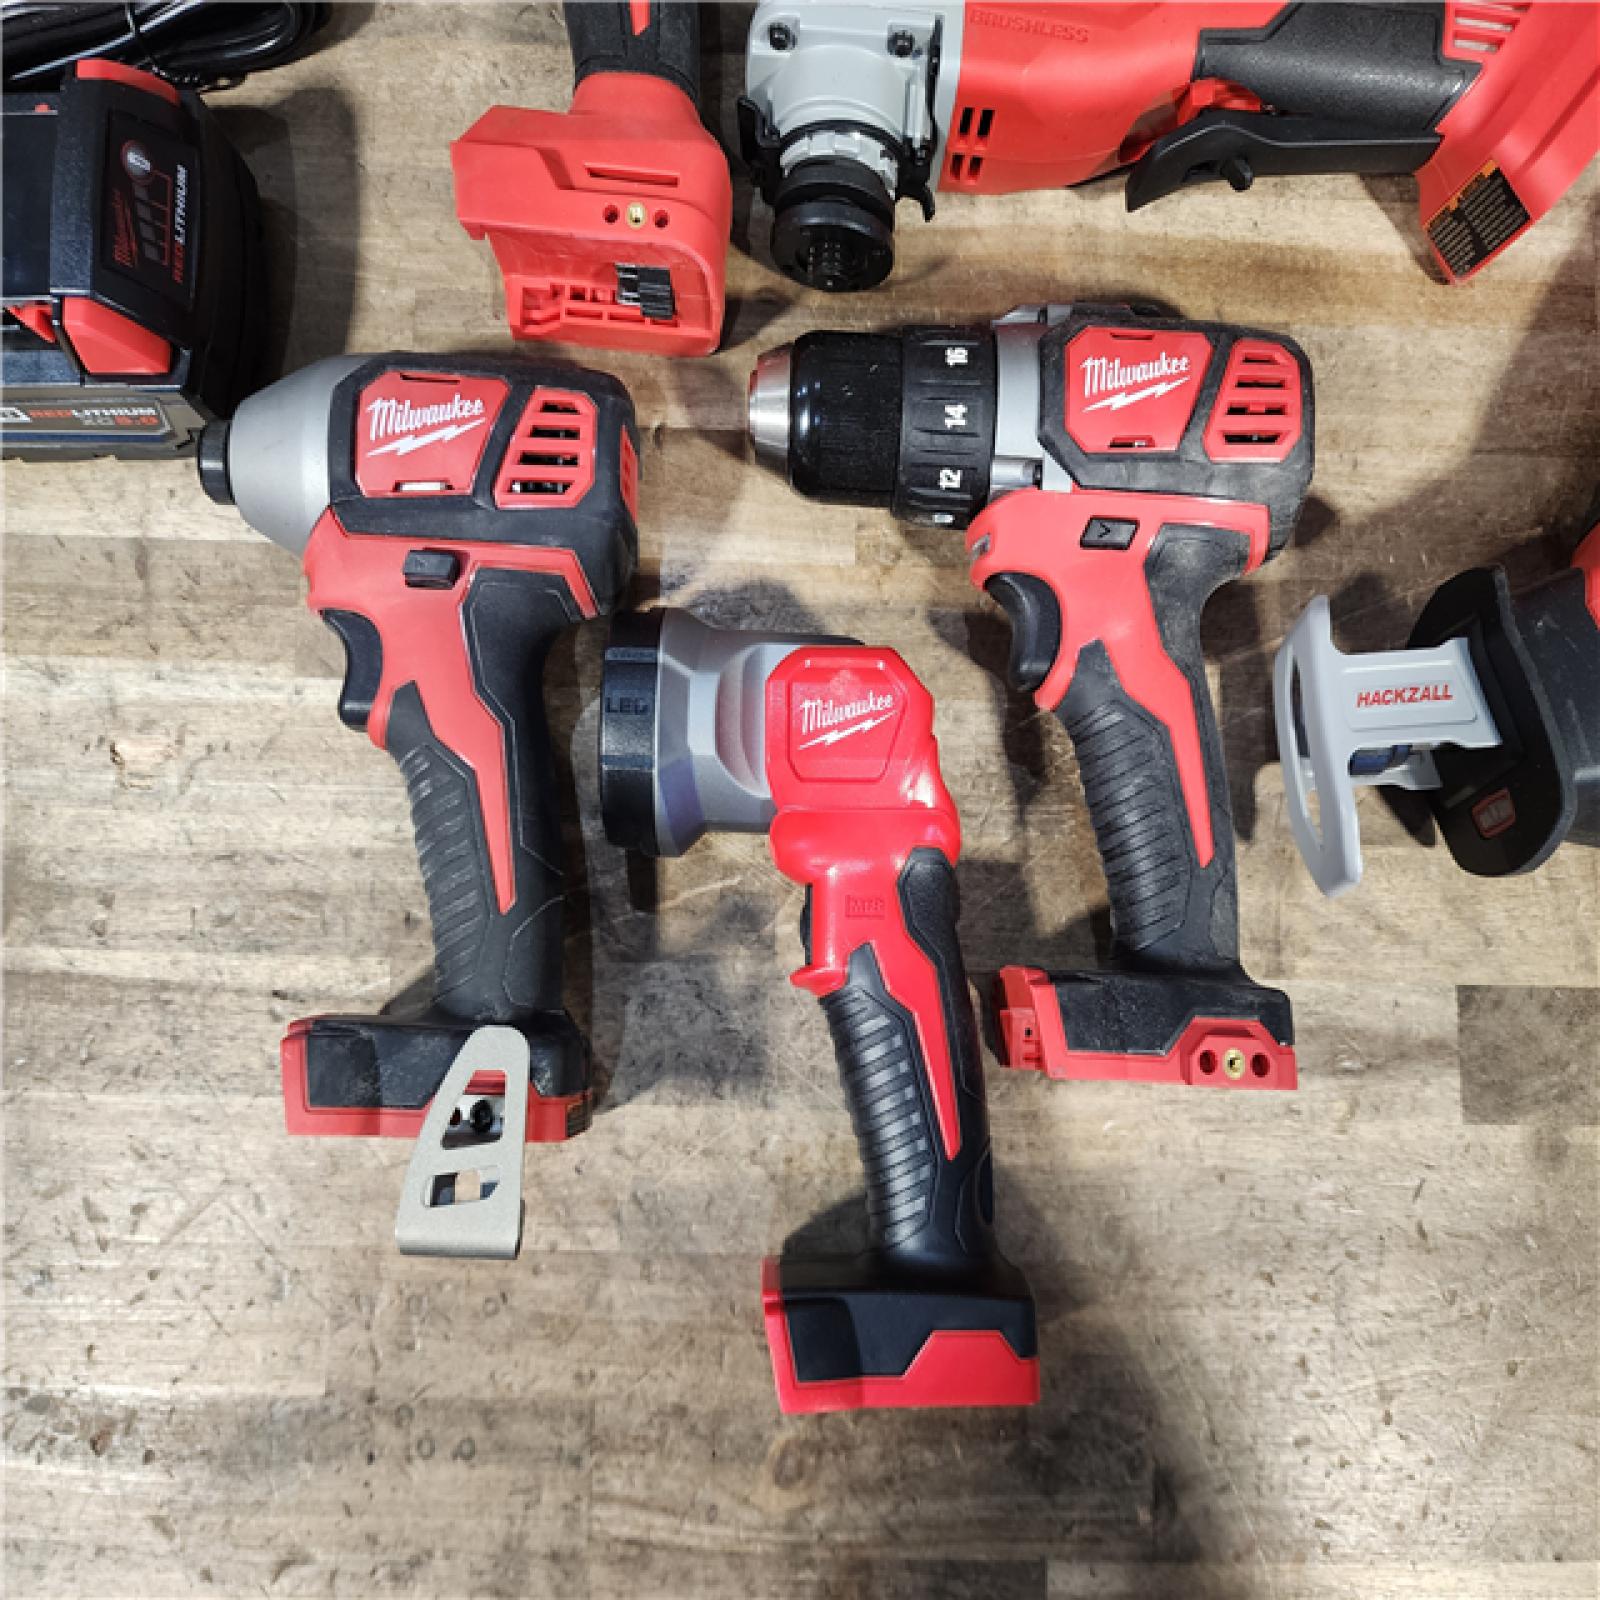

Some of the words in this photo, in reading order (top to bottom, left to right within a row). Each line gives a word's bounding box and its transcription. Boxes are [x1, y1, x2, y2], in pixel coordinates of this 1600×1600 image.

[970, 8, 1089, 43] BRUSHLESS
[1080, 350, 1190, 399] Milwaukee
[366, 392, 484, 441] Milwaukee
[944, 402, 969, 430] 14
[799, 690, 894, 735] Milwaukee
[1356, 683, 1453, 708] HACKZALL
